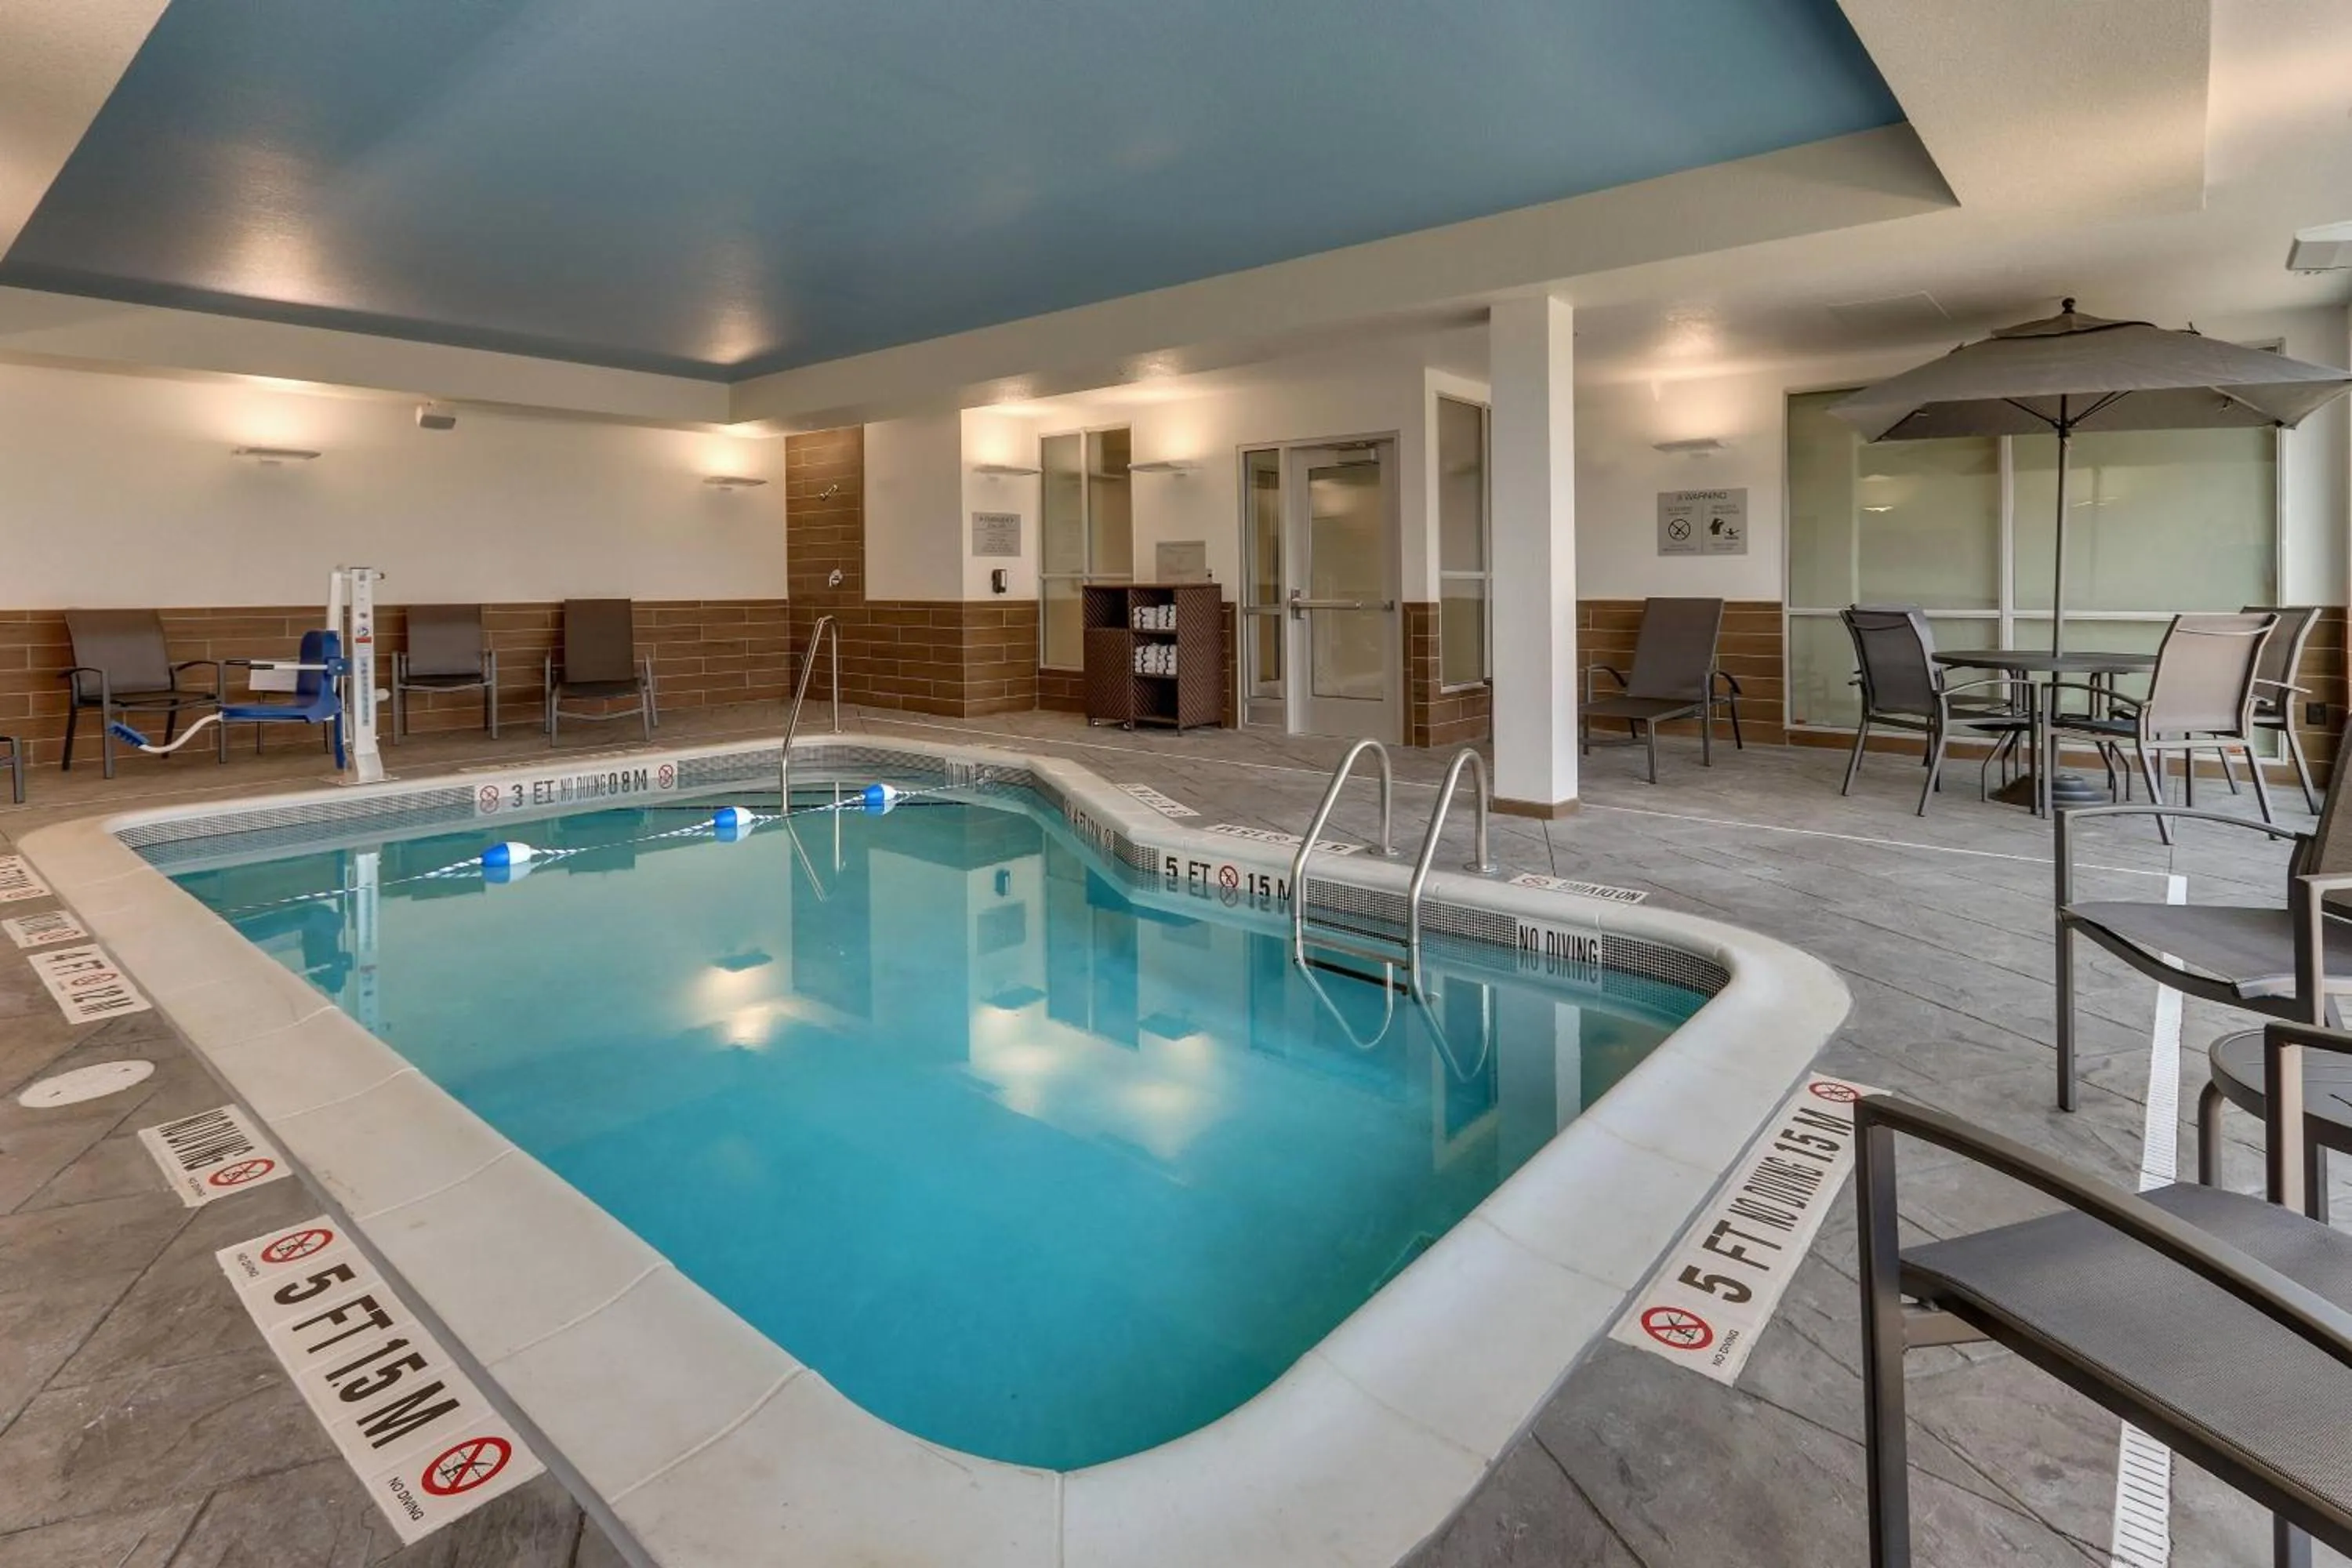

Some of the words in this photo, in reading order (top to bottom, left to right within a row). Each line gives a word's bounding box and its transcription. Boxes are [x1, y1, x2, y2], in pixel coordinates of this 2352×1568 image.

[1166, 856, 1178, 877] 5
[1189, 860, 1210, 884] FT
[1519, 925, 1539, 952] NO
[1547, 931, 1598, 965] DIVING
[1792, 1108, 1854, 1136] M
[1743, 1156, 1824, 1210] DIVING
[1727, 1197, 1798, 1232] NO
[1702, 1219, 1783, 1272] FT
[274, 1263, 356, 1305] 5
[1678, 1265, 1752, 1303] 5
[292, 1294, 394, 1354] FT
[325, 1338, 428, 1403] 1.5
[1712, 1354, 1726, 1367] NO
[356, 1380, 461, 1449] M
[388, 1476, 404, 1491] NO
[397, 1490, 424, 1521] DIVING
